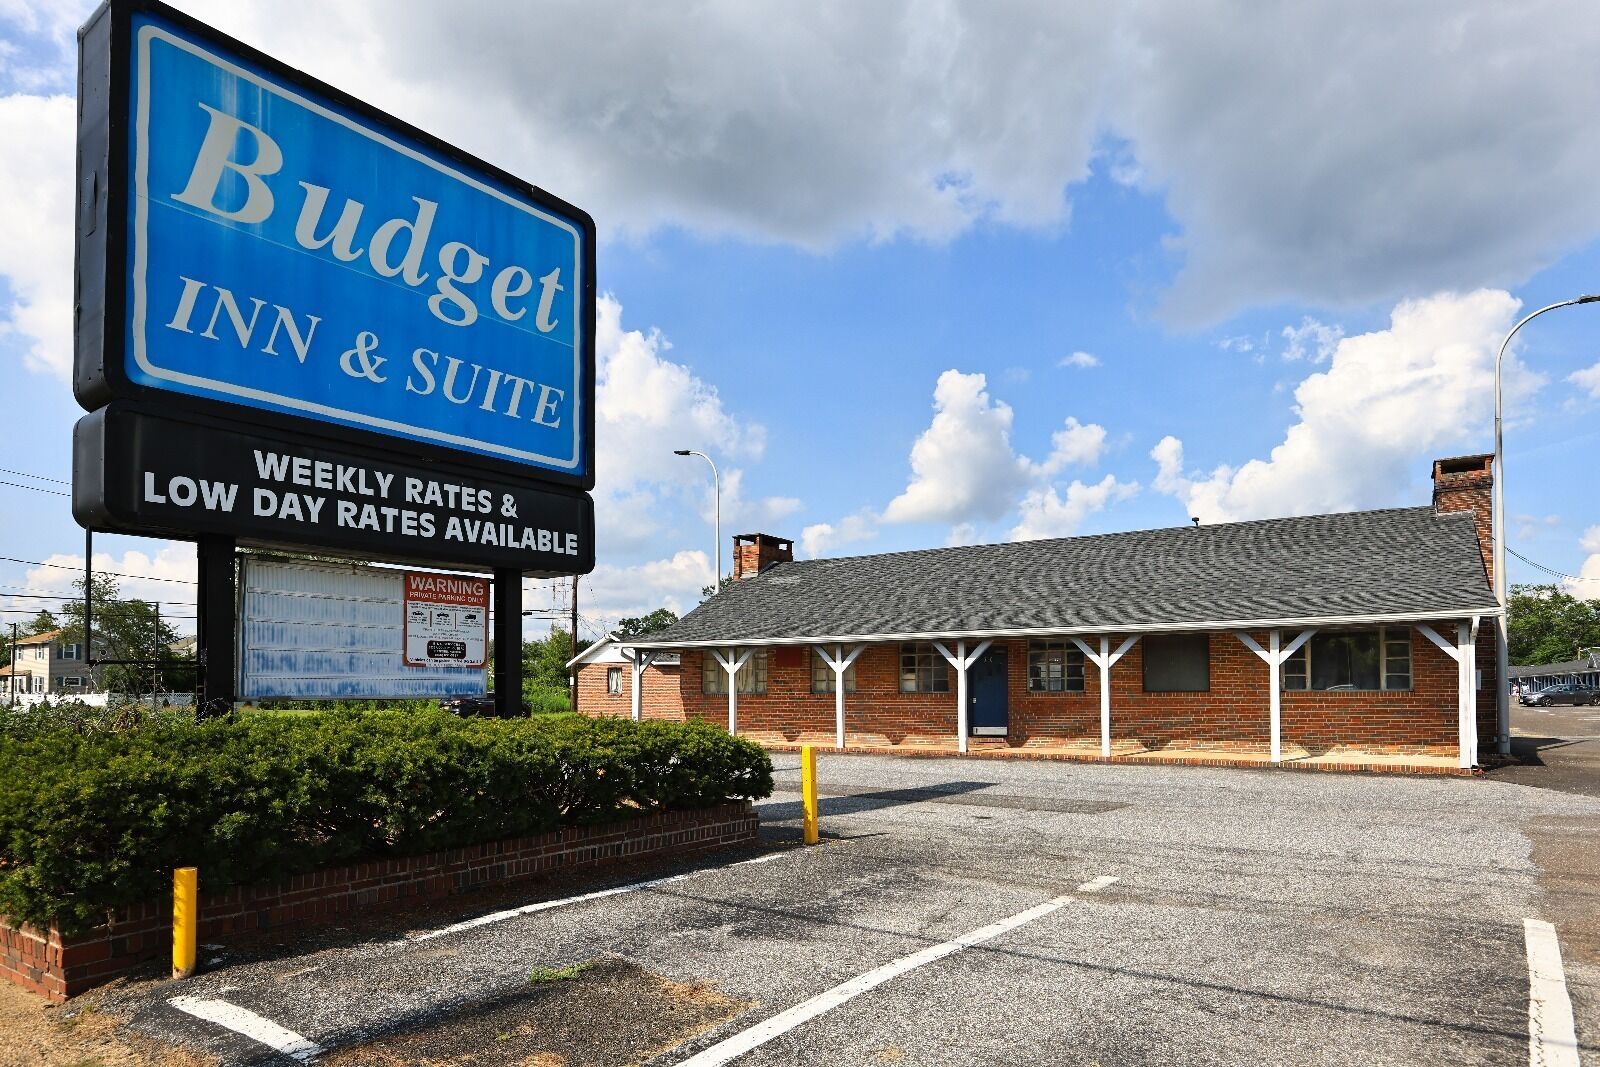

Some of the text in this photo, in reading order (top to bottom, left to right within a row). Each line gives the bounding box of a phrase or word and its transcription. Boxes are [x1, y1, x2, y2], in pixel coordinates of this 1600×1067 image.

[171, 101, 564, 333] Budget
[165, 275, 565, 429] INN & SUITE
[144, 471, 578, 556] LOW DAY RATES AVAILABLE
[254, 449, 518, 519] WEEKLY RATES &
[409, 591, 437, 600] PRIVATE
[438, 594, 466, 602] PARKING
[410, 576, 483, 596] WARNING
